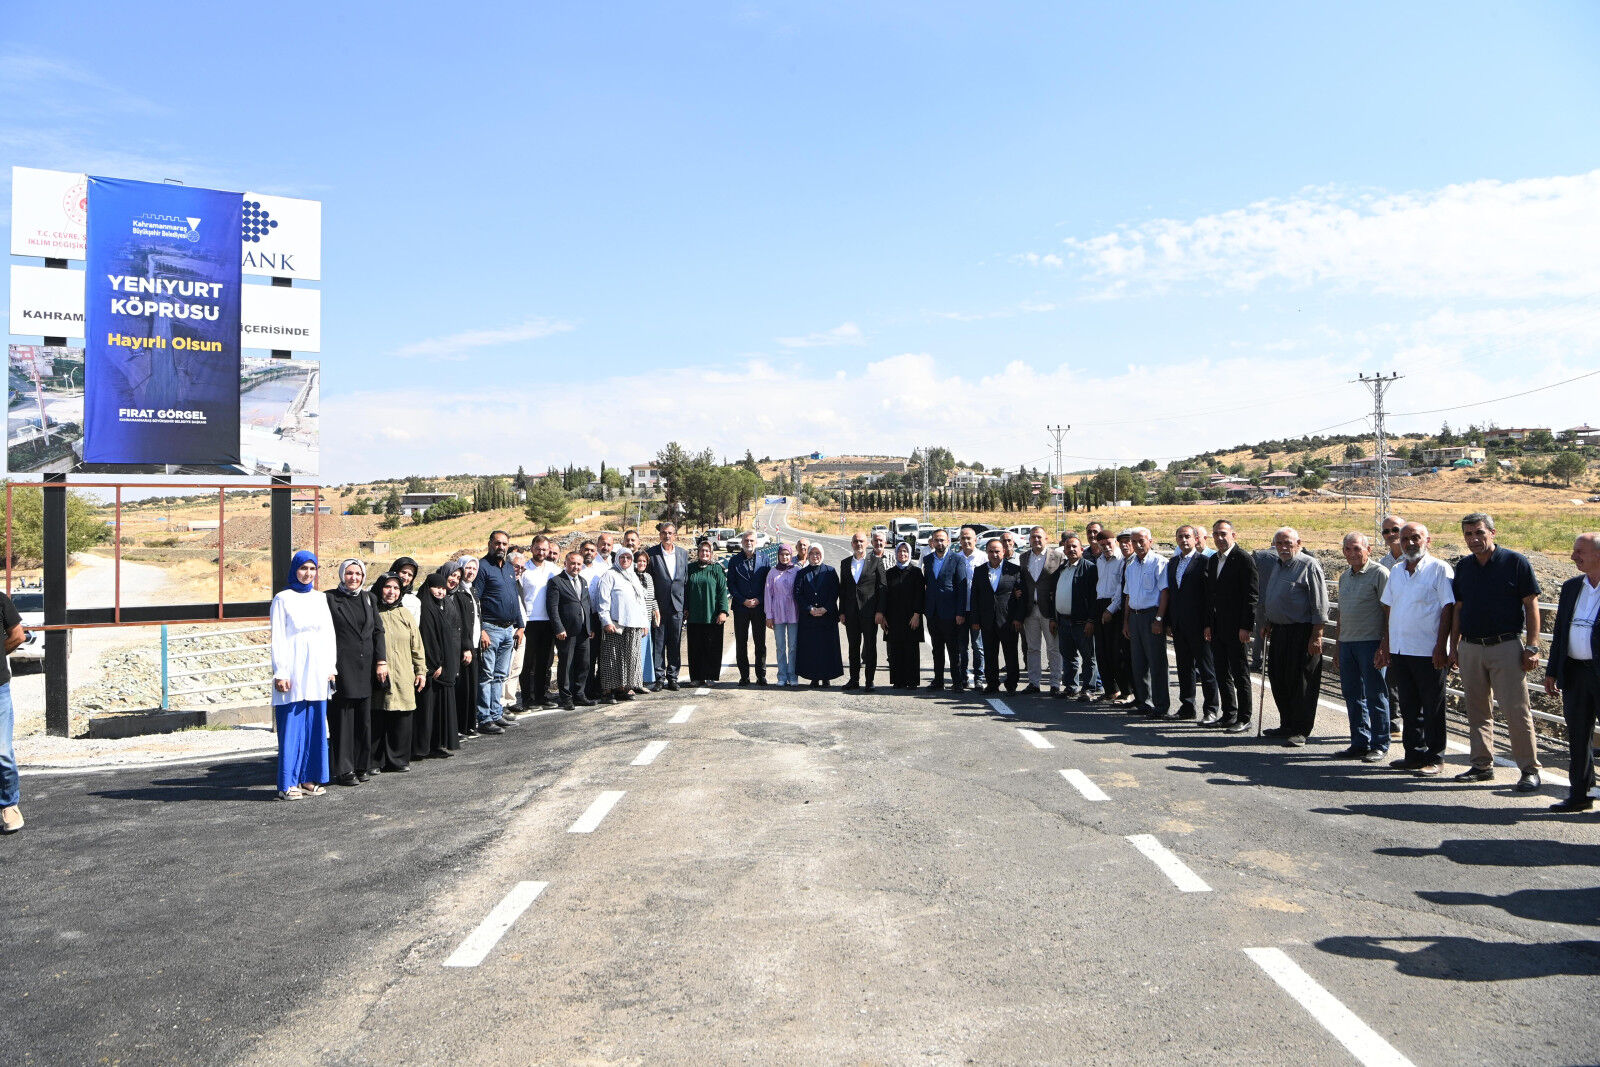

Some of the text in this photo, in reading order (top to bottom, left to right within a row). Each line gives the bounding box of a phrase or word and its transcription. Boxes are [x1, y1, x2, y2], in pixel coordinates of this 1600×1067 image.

[132, 220, 188, 233] Kahramanmaraş
[161, 230, 188, 239] Belediyesi
[23, 309, 86, 322] KAHRAM
[107, 333, 222, 352] Hayırlı Olsun
[118, 408, 207, 420] FIRAT GÖRGEL
